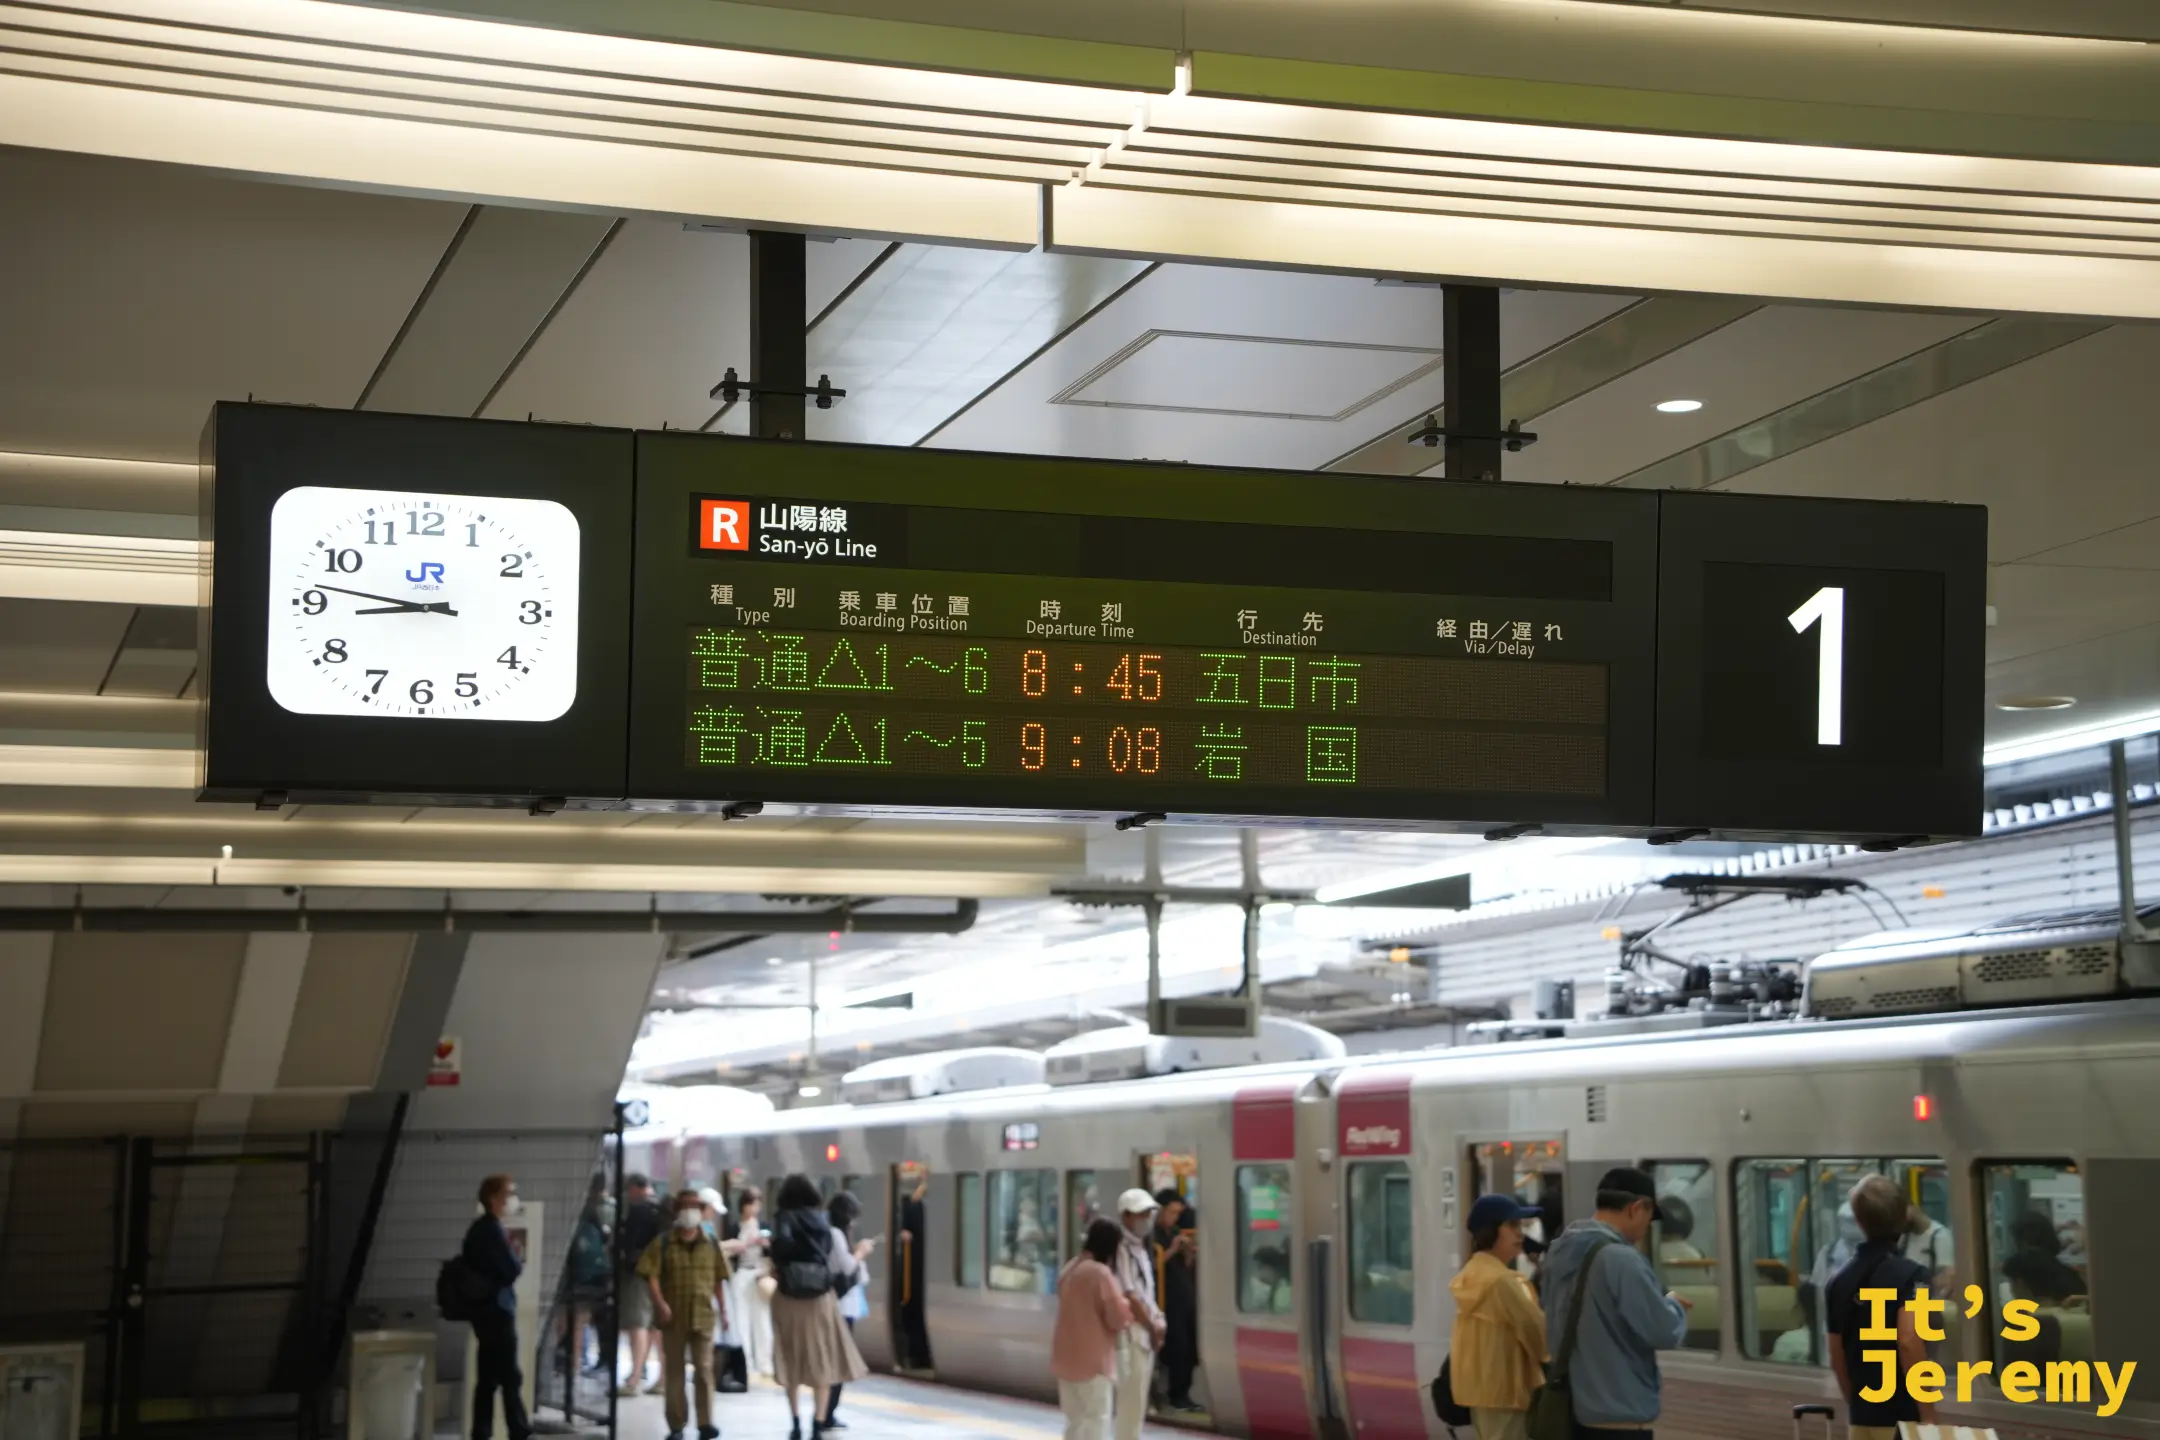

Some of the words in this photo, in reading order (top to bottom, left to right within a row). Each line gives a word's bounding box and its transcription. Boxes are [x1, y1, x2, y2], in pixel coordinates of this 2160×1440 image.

[406, 511, 445, 536] 12
[712, 507, 740, 544] R
[759, 504, 848, 533] 山陽線
[364, 520, 398, 546] 11
[465, 523, 480, 547] 1
[759, 534, 829, 560] San-yō
[835, 538, 877, 558] Line
[324, 548, 363, 573] 10
[405, 562, 445, 584] JR
[500, 553, 524, 578] 2
[302, 590, 328, 616] 9
[710, 584, 795, 609] 種別
[838, 590, 970, 616] 乗車位置
[518, 600, 542, 625] 3
[735, 607, 770, 626] Type
[840, 611, 905, 631] Boarding
[910, 615, 968, 631] Position
[1039, 600, 1122, 623] 時刻
[1236, 608, 1323, 632] 行先
[1026, 620, 1096, 638] Departure
[1101, 622, 1134, 638] Time
[1243, 631, 1317, 647] Destination
[322, 638, 349, 664] 8
[496, 645, 522, 670] 4
[1465, 639, 1535, 658] Via/Delay
[1787, 586, 1844, 746] 1
[365, 669, 389, 694] 7
[409, 679, 434, 705] 6
[454, 671, 479, 697] 5
[1196, 654, 1361, 711] 五日市
[1194, 722, 1357, 783] 岩国
